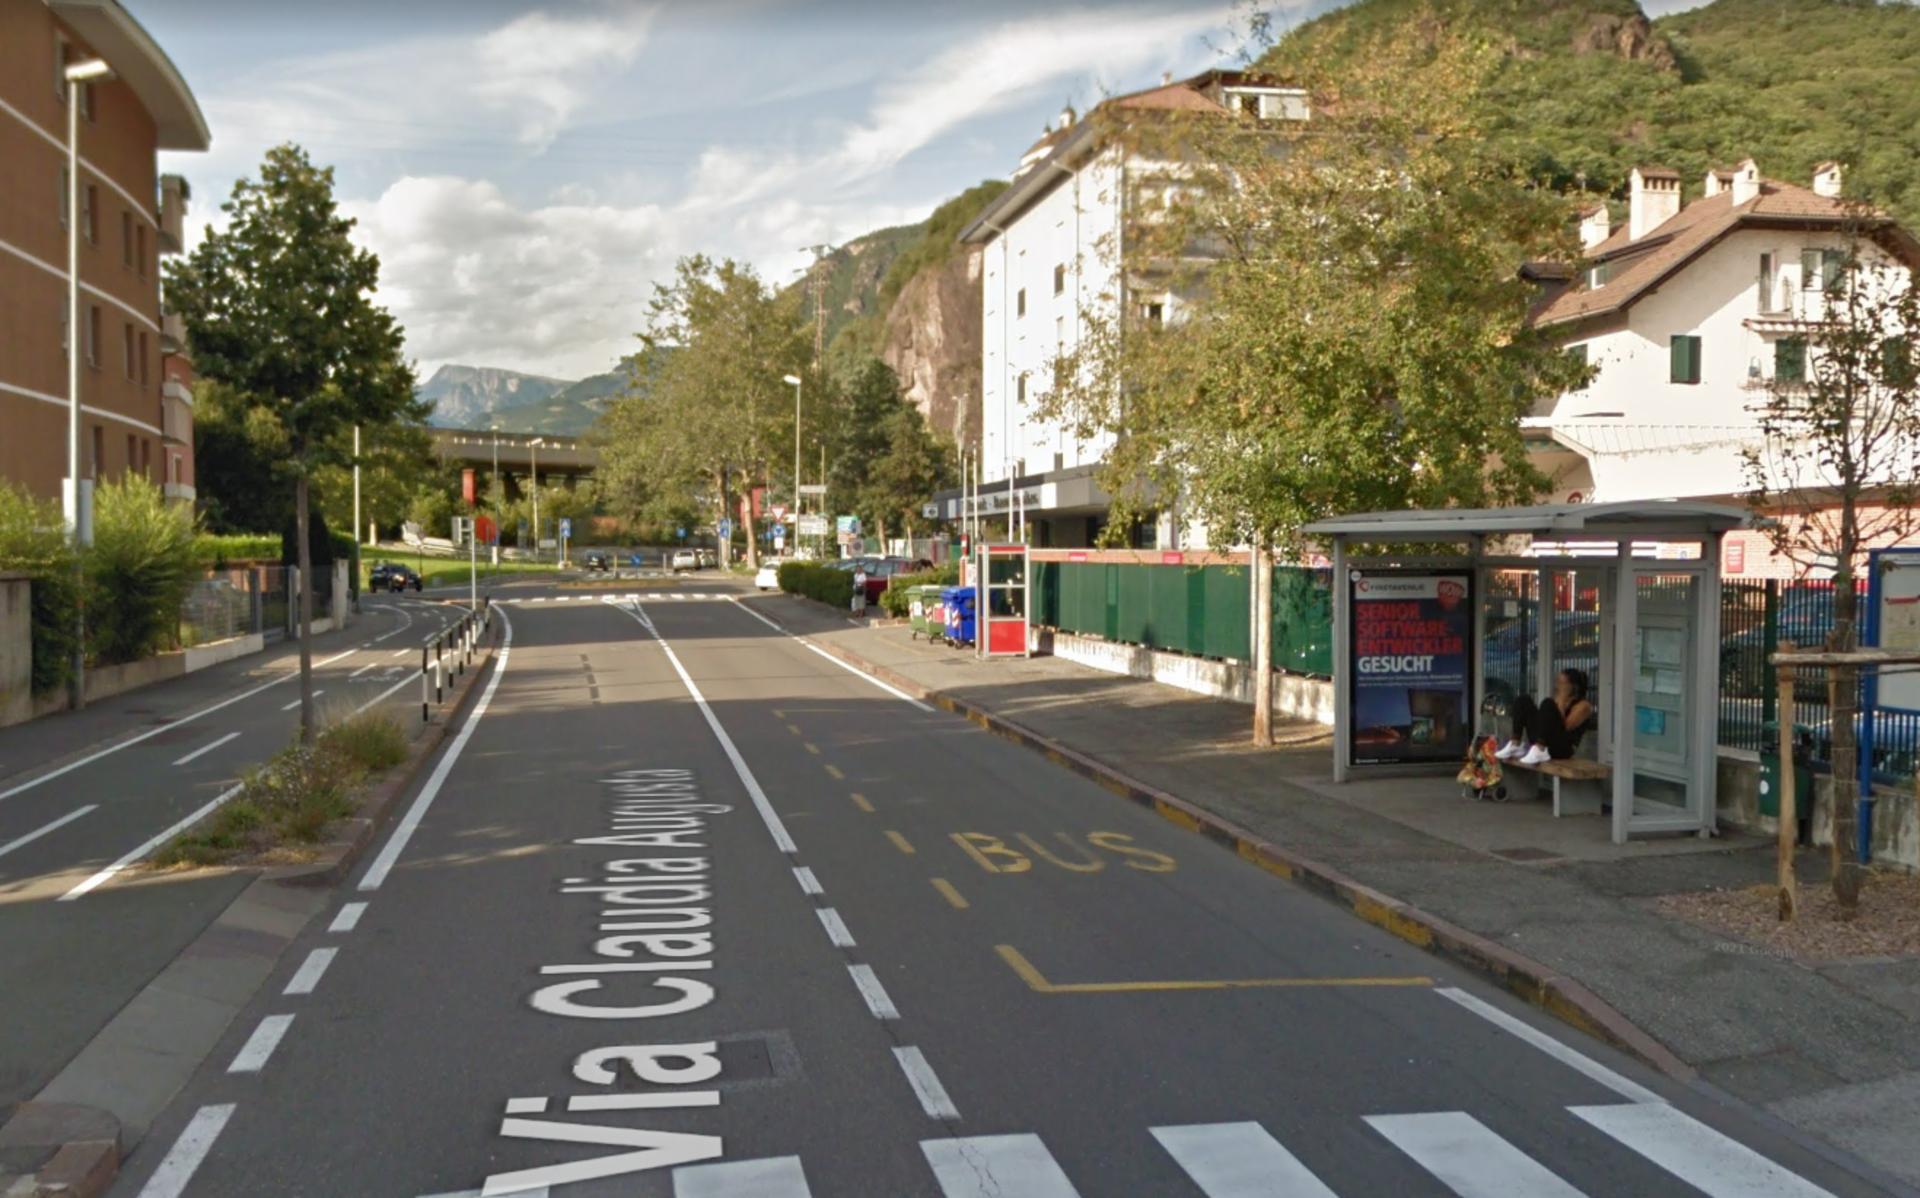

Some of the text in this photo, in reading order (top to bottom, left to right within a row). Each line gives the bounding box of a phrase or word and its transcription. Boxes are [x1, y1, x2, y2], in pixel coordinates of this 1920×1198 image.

[1357, 603, 1420, 620] SENIOR
[1358, 655, 1434, 673] GESUCHT
[949, 831, 1177, 872] BUS
